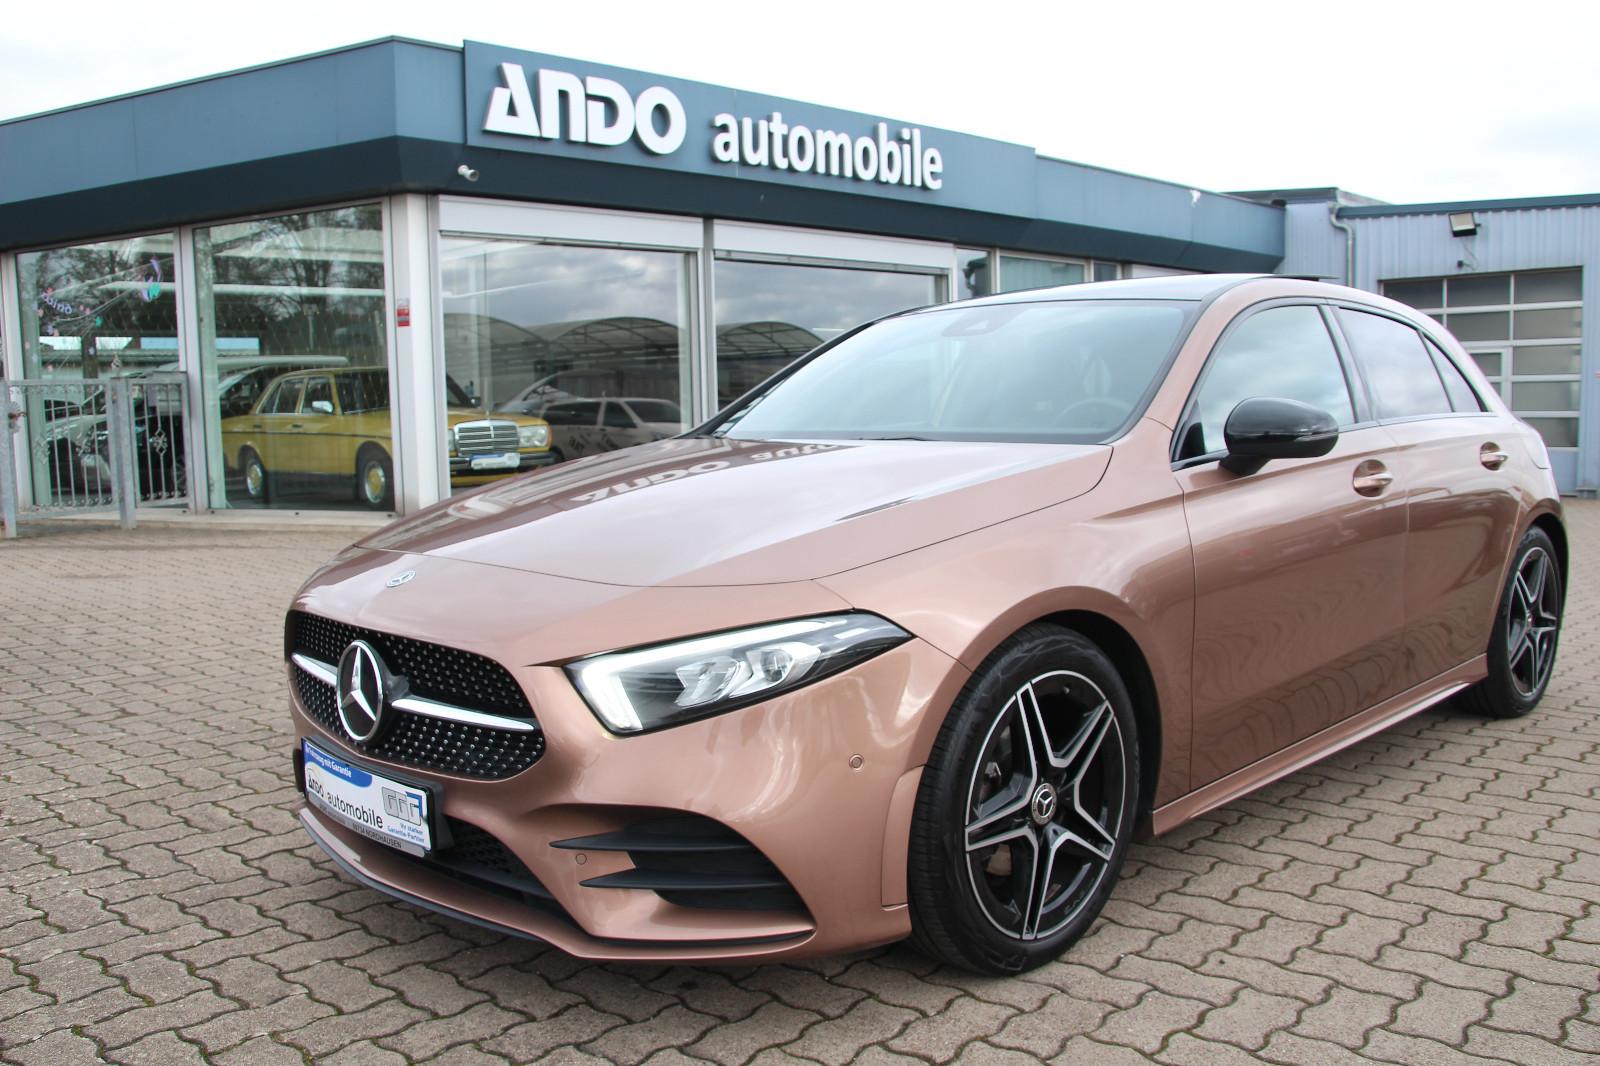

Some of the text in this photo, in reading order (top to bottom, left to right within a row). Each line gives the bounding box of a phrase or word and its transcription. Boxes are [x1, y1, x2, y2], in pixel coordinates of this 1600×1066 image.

[482, 62, 943, 190] ANDO automobile
[326, 791, 384, 829] automobile
